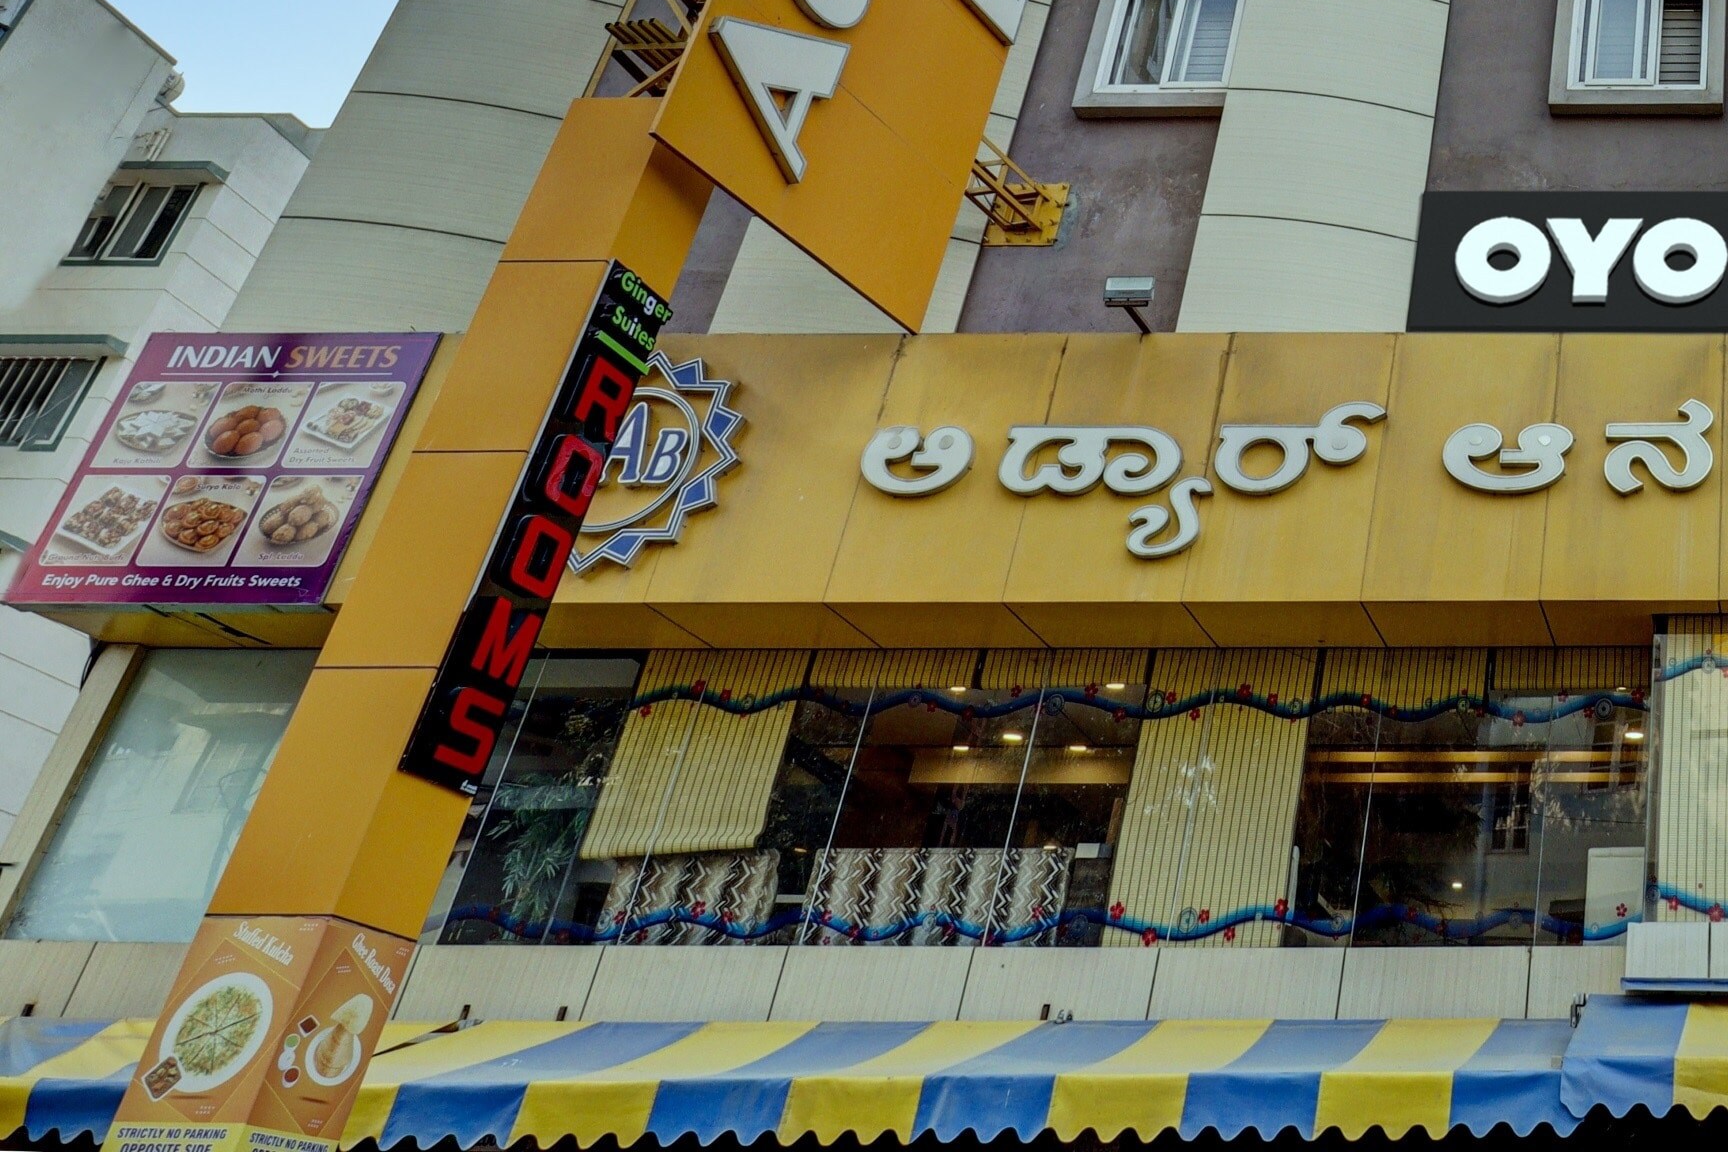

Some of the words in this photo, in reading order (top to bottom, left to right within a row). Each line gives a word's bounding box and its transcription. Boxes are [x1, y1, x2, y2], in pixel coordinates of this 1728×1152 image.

[1455, 216, 1728, 308] OYO
[621, 271, 672, 322] Ginger
[612, 305, 656, 351] Suites
[167, 346, 282, 368] INDIAN
[284, 346, 401, 368] SWEETS
[42, 574, 83, 589] Enjoy
[86, 575, 119, 586] Pure
[122, 575, 160, 587] Ghee
[163, 576, 172, 586] &
[174, 576, 203, 589] Dry
[203, 575, 246, 587] Fruits
[249, 575, 301, 587] Sweets
[433, 356, 634, 775] ROOMS
[233, 921, 268, 950] Stuffed
[263, 935, 294, 966] Kulcha
[352, 932, 368, 958] Ghee
[364, 948, 385, 978] Roast
[379, 967, 396, 995] Dosa
[117, 1128, 165, 1139] STRICTLY
[166, 1128, 181, 1139] NO
[183, 1129, 227, 1139] PARKING
[120, 1143, 181, 1152] OPPOSITE
[249, 1132, 285, 1147] STRICTLY
[285, 1138, 297, 1150] NO
[297, 1140, 329, 1152] PARKING
